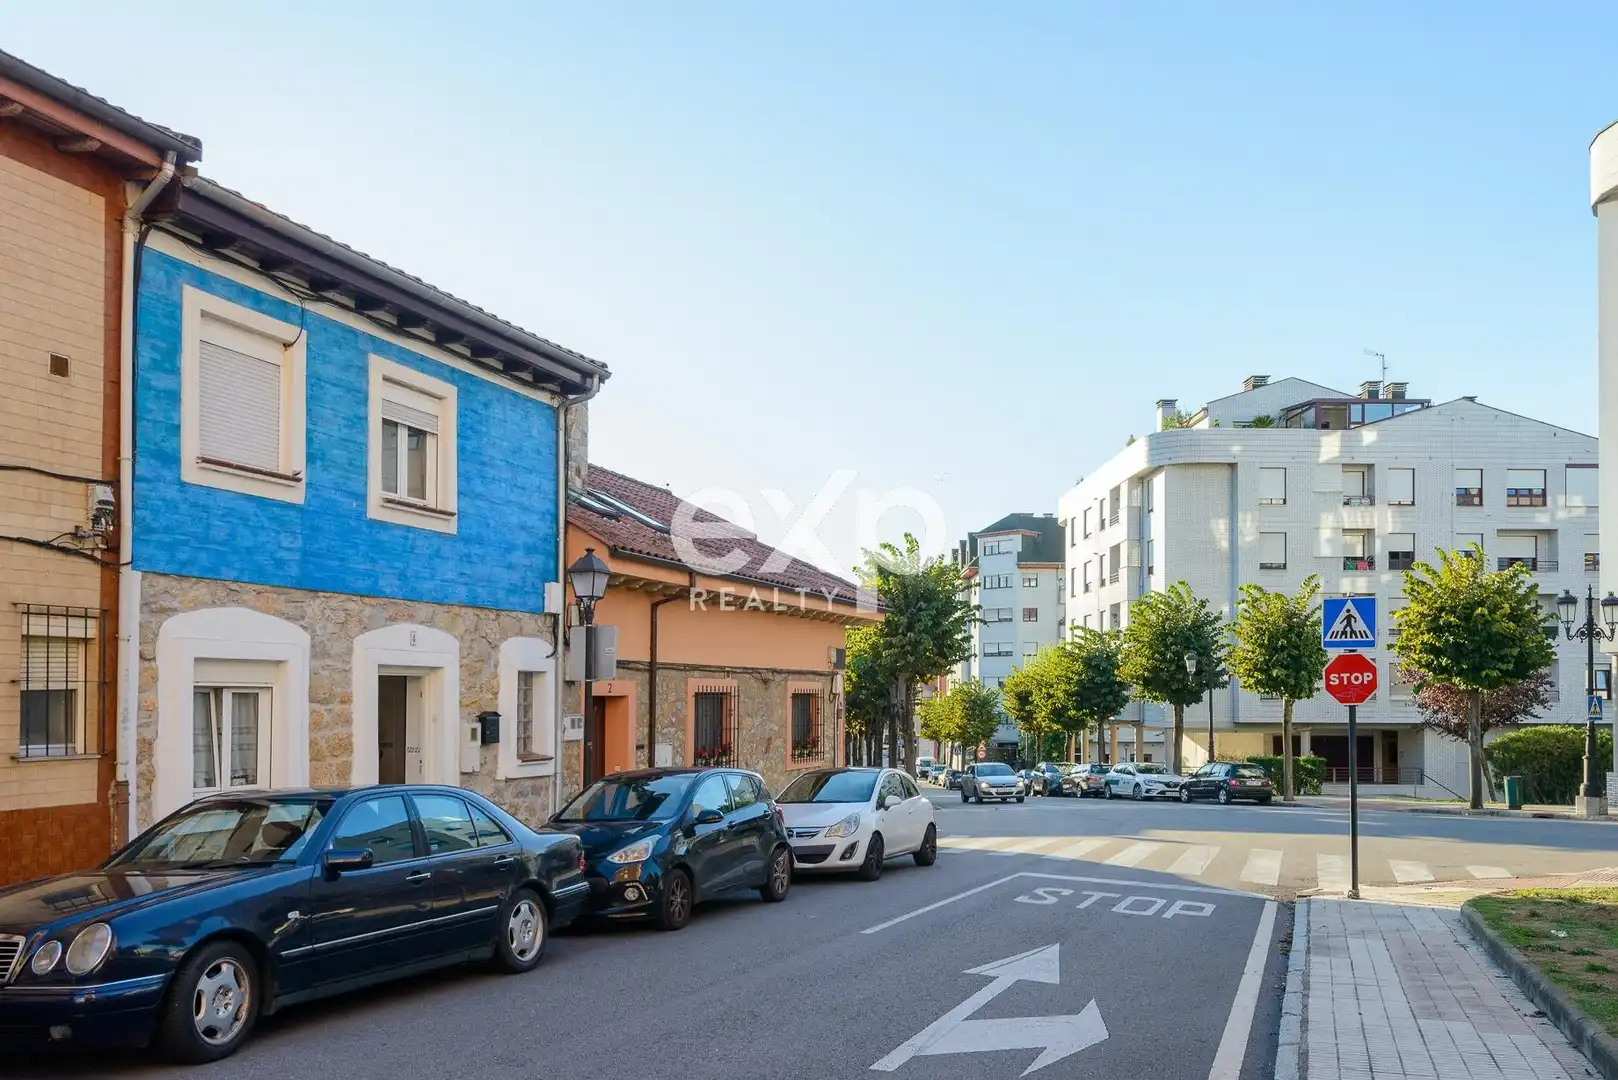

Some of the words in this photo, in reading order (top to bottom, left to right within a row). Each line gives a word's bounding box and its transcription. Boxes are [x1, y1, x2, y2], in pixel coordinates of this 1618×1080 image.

[1329, 673, 1373, 686] STOP
[607, 683, 612, 693] 2
[1013, 887, 1217, 919] STOP
